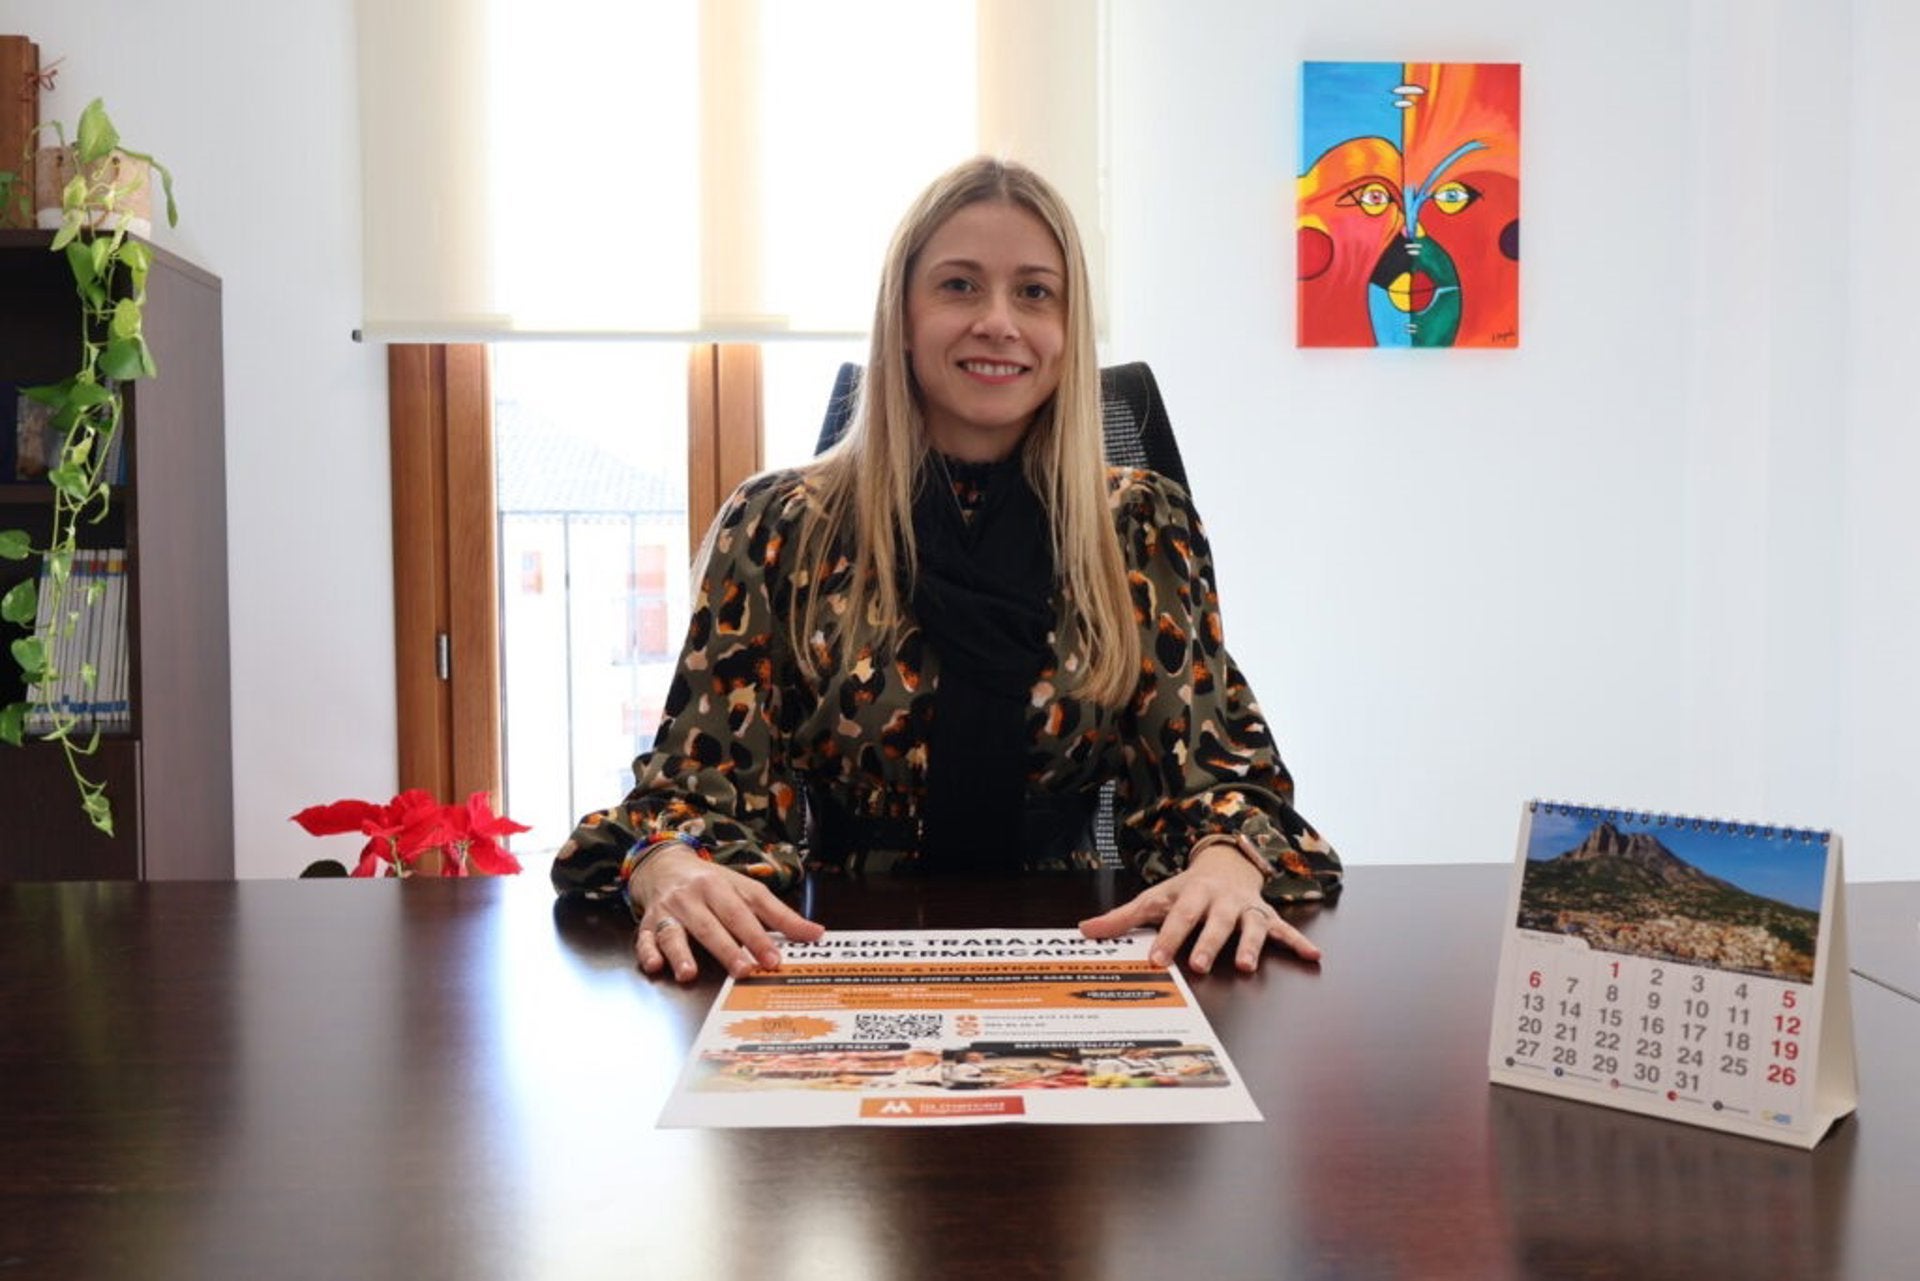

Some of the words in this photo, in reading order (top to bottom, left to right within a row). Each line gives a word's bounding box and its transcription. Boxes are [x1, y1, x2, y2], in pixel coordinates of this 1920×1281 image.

[787, 950, 832, 959] UN
[841, 948, 1118, 959] SUPERMERCADO?
[926, 937, 1086, 947] TRABAJAR
[1529, 970, 1542, 988] 6
[1566, 976, 1579, 994] 7
[1606, 984, 1619, 1002] 8
[1647, 992, 1661, 1010] 9
[1684, 999, 1710, 1019] 10
[1728, 1005, 1749, 1025] 11
[1774, 1014, 1802, 1036] 12
[1609, 961, 1620, 979] 1
[1650, 968, 1664, 986] 2
[1691, 974, 1705, 993] 3
[1734, 983, 1748, 1000] 4
[1782, 990, 1797, 1009] 5
[1518, 1015, 1542, 1035] 20
[1554, 1022, 1577, 1042] 21
[1594, 1030, 1621, 1051] 22
[1635, 1038, 1662, 1060] 23
[1677, 1047, 1703, 1068] 24
[1720, 1054, 1748, 1077] 25
[1766, 1063, 1797, 1086] 26
[1522, 993, 1545, 1012] 13
[1559, 1000, 1581, 1018] 14
[1600, 1007, 1622, 1027] 15
[1640, 1015, 1665, 1035] 16
[1681, 1022, 1707, 1042] 17
[1725, 1031, 1751, 1051] 18
[1771, 1039, 1799, 1061] 19
[1516, 1038, 1541, 1058] 27
[1552, 1046, 1577, 1066] 28
[1592, 1053, 1619, 1075] 29
[1633, 1062, 1661, 1084] 30
[1674, 1070, 1700, 1092] 31
